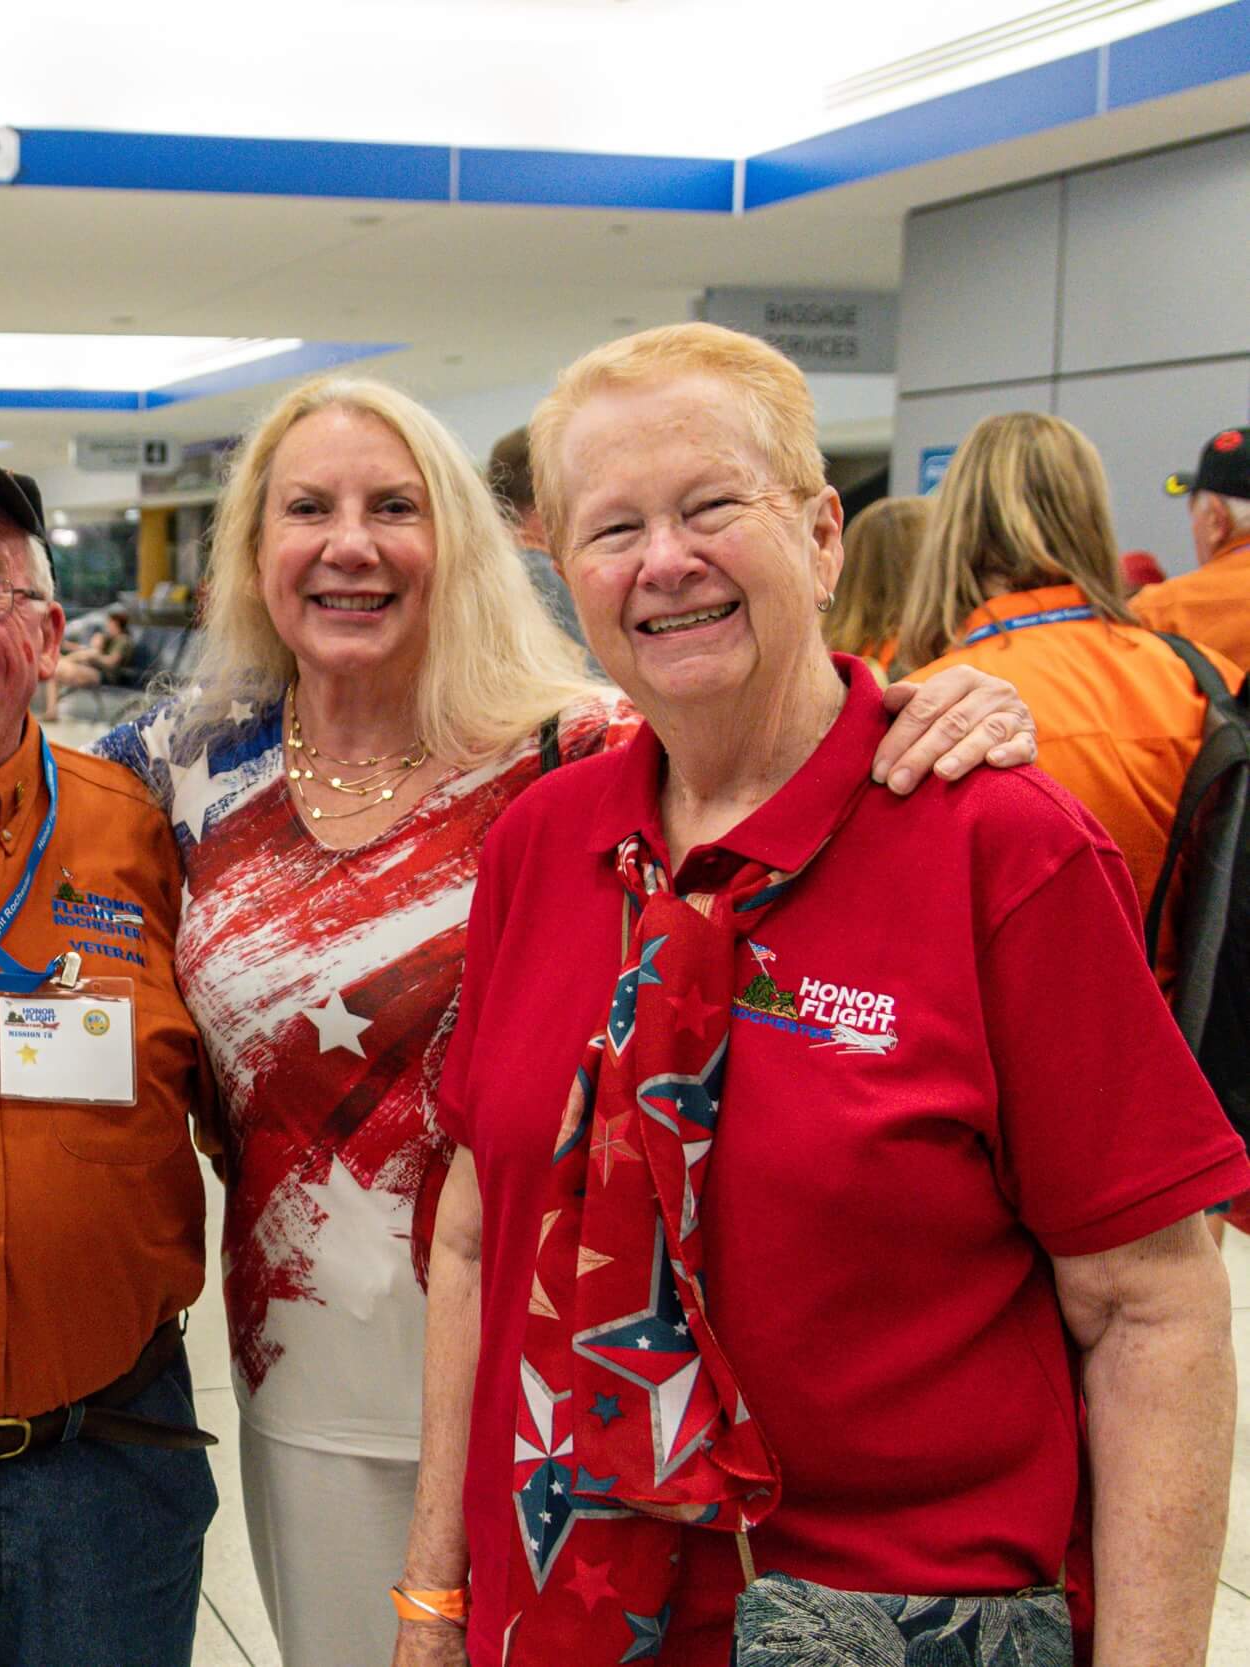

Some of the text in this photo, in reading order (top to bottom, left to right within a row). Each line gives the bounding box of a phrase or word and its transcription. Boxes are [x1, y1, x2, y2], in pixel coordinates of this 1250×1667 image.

[765, 303, 856, 326] BAGGAGE
[54, 914, 141, 939] ROCHESTER
[68, 940, 145, 967] VETERAN
[799, 976, 895, 1014] HONOR
[25, 1014, 57, 1022] FLIGHT
[799, 998, 896, 1032] FLIGHT
[9, 1030, 41, 1038] MISSION
